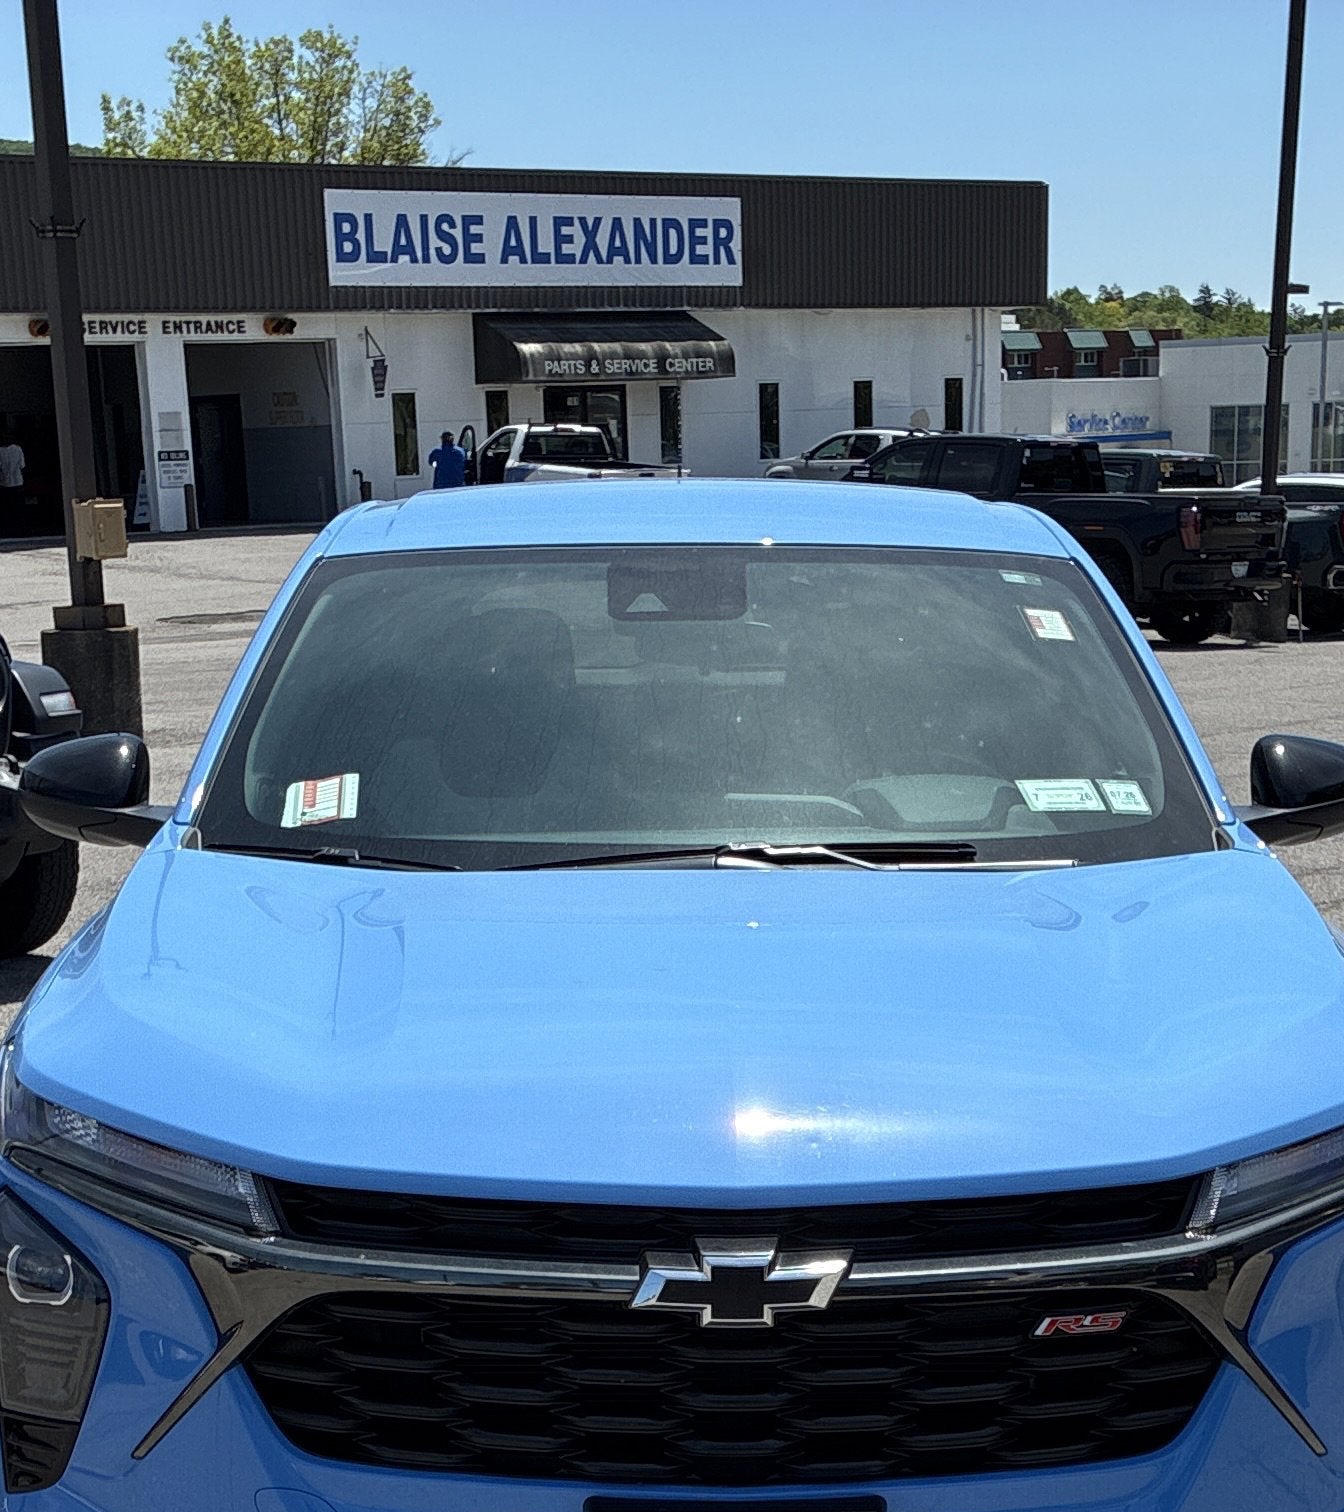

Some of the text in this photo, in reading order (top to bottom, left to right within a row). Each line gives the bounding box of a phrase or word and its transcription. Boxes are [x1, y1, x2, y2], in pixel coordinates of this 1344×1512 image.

[333, 212, 737, 266] BLAISE ALEXANDER
[162, 319, 246, 335] ENTRANCE
[544, 357, 715, 375] PARTS & SERVICE CENTER
[1033, 1311, 1127, 1336] RS
